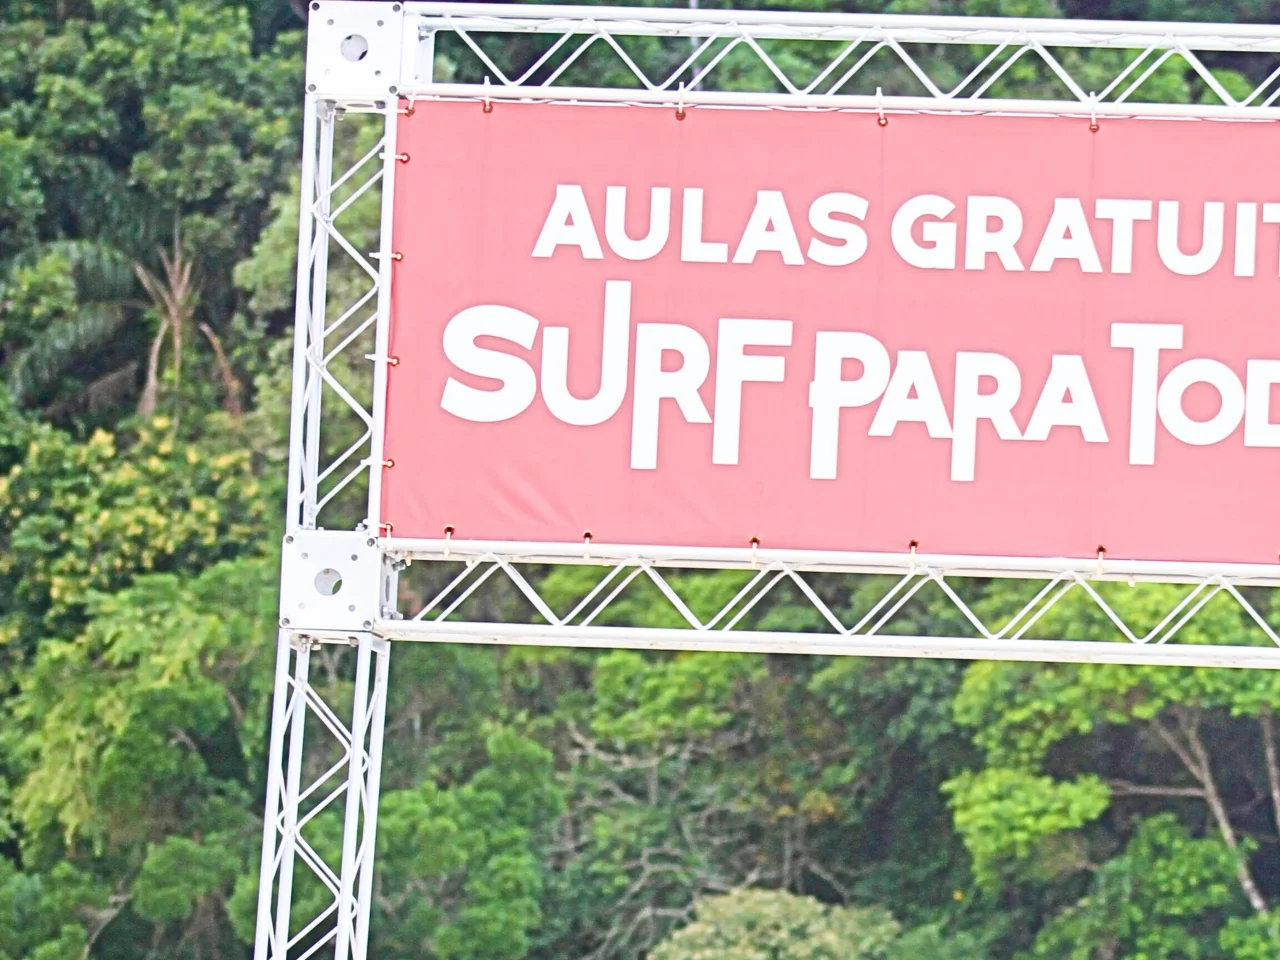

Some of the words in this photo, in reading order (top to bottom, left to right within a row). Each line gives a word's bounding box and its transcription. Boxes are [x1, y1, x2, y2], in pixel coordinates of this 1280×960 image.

[532, 185, 869, 267] AULAS
[440, 280, 793, 469] SURF
[809, 331, 1109, 481] PARA
